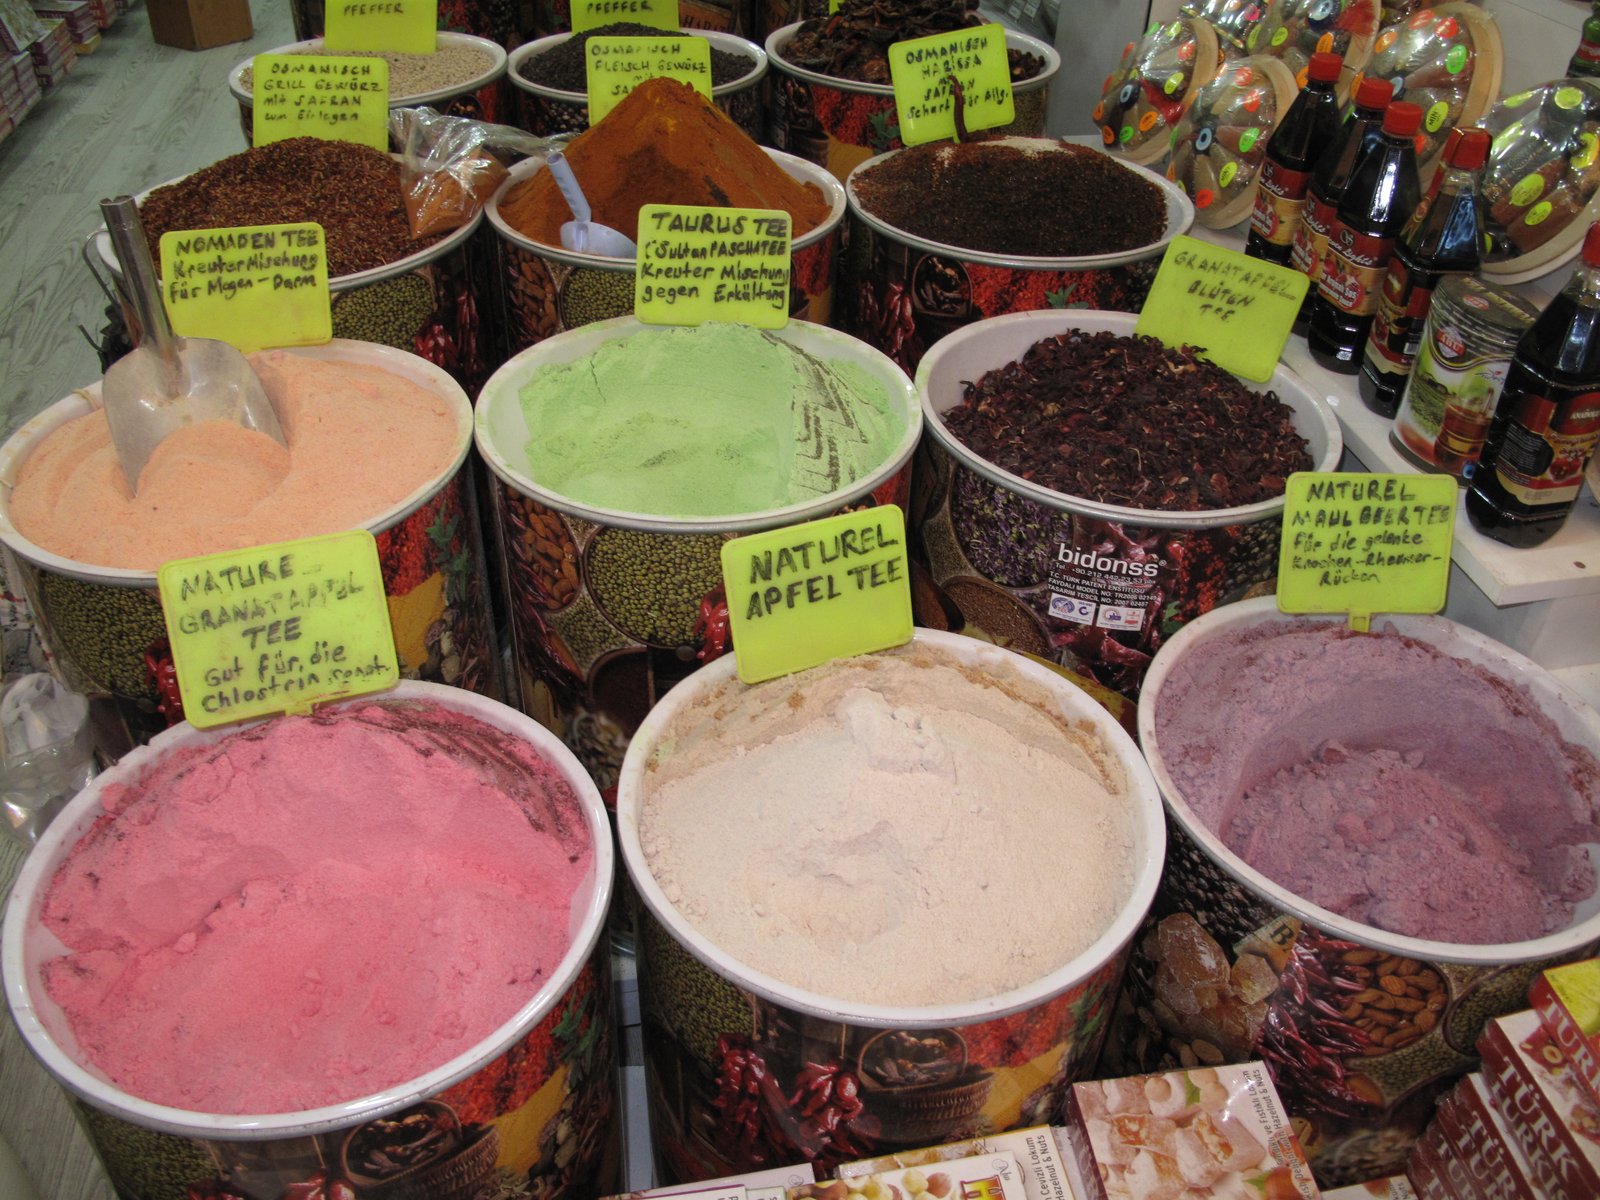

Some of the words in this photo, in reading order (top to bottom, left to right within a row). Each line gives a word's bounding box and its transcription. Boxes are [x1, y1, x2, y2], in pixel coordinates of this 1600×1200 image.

[344, 3, 404, 17] PFEFFER
[587, 0, 654, 14] PFEFFER
[595, 61, 650, 73] FLEISCH
[263, 80, 306, 91] GRILL
[295, 95, 362, 106] SAFRAN
[651, 211, 748, 235] TAURUS
[753, 218, 787, 238] TEE
[175, 231, 276, 257] NOMADEN
[281, 229, 319, 248] TEE
[640, 261, 715, 280] Kreuter
[641, 284, 699, 305] gegen
[714, 282, 786, 310] Erkältung
[1330, 530, 1357, 551] die
[750, 524, 900, 585] NATUREL
[746, 575, 842, 621] APFEL
[847, 556, 903, 591] TEE
[1076, 584, 1100, 596] MODEL
[1081, 579, 1107, 590] PATENT
[241, 616, 303, 650] TEE
[204, 656, 244, 687] Gut
[310, 640, 347, 666] die
[1252, 1068, 1265, 1089] Nuts
[1262, 1096, 1283, 1130] Hazelnut
[1498, 1055, 1580, 1181] TÜRK
[1025, 1136, 1041, 1166] Lokum
[1036, 1134, 1051, 1155] Nuts
[1033, 1166, 1051, 1196] Cevizli
